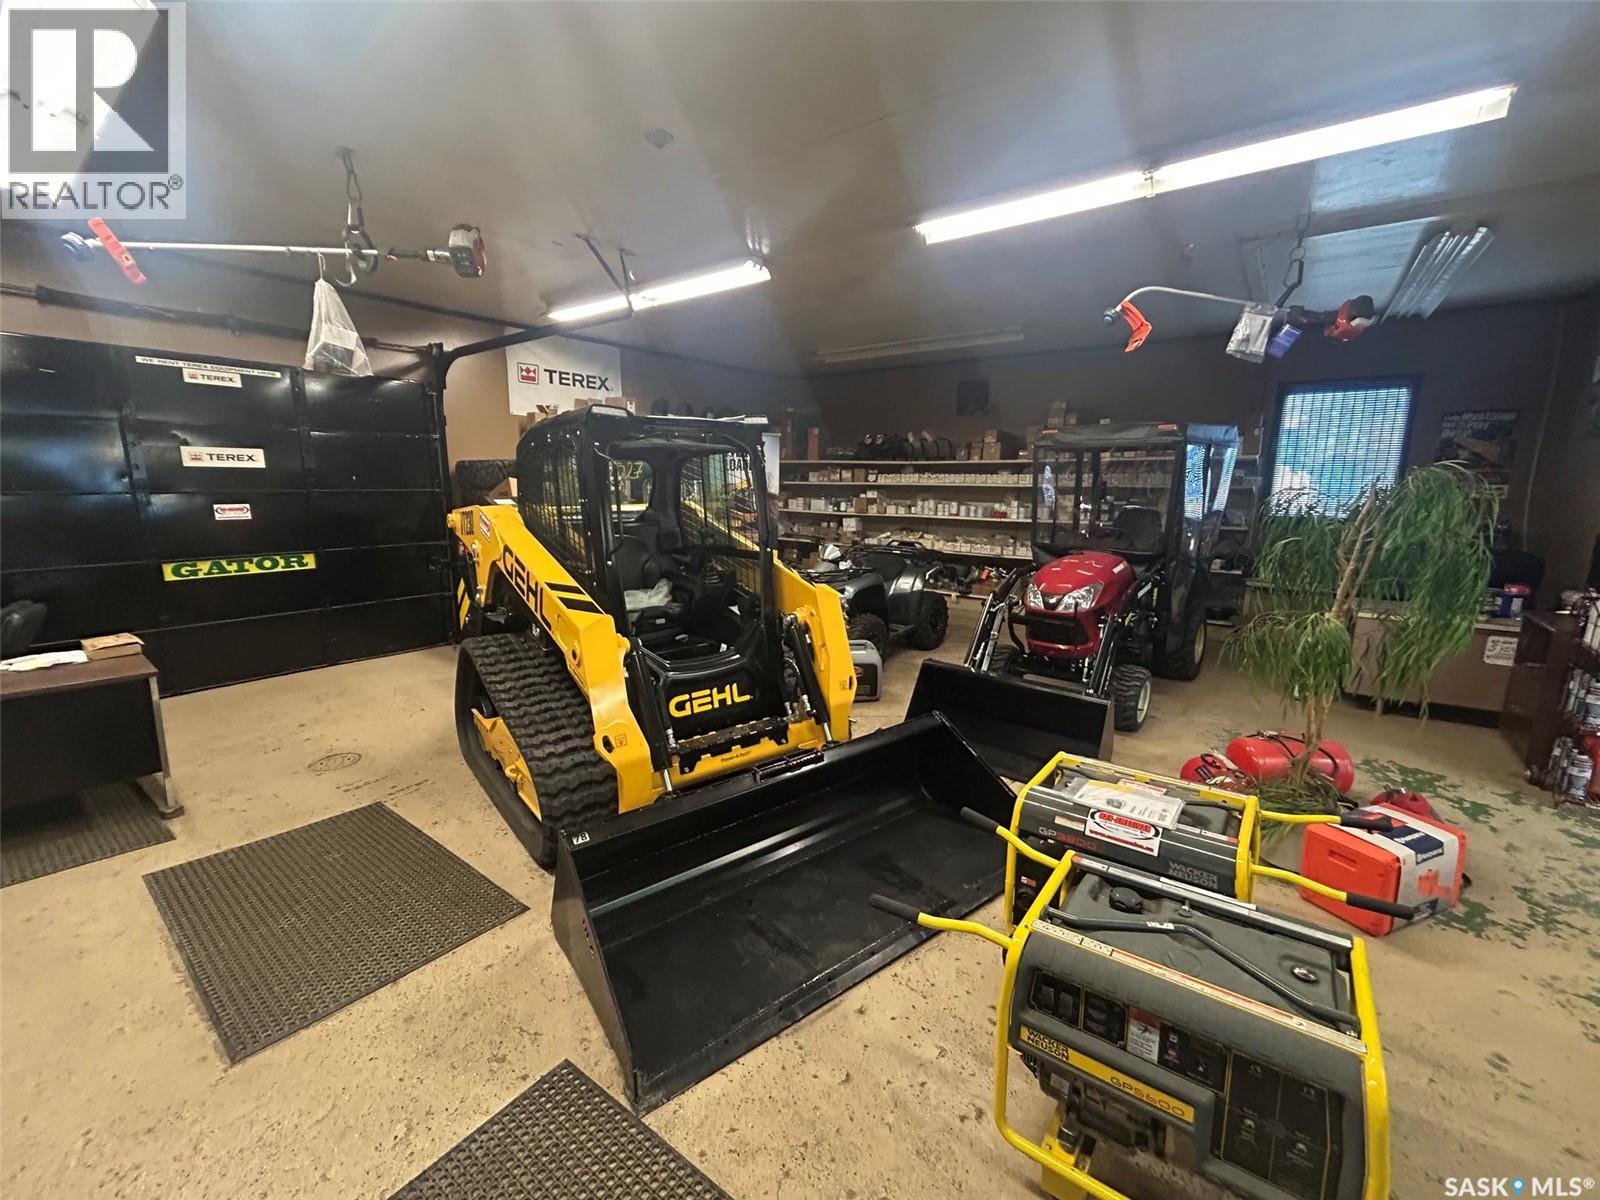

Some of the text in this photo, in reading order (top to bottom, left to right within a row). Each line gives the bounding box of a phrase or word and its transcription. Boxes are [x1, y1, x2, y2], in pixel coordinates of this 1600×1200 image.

[200, 373, 235, 383] TEREX
[543, 368, 610, 391] TEREX
[206, 453, 256, 462] TEREX
[171, 554, 308, 578] GATOR
[503, 543, 552, 632] GEHL
[668, 682, 751, 718] GEHL
[1168, 860, 1218, 880] WACKER
[1168, 868, 1218, 890] NEUSON
[1027, 1028, 1069, 1053] WACKER
[1027, 1035, 1069, 1061] NEUSON
